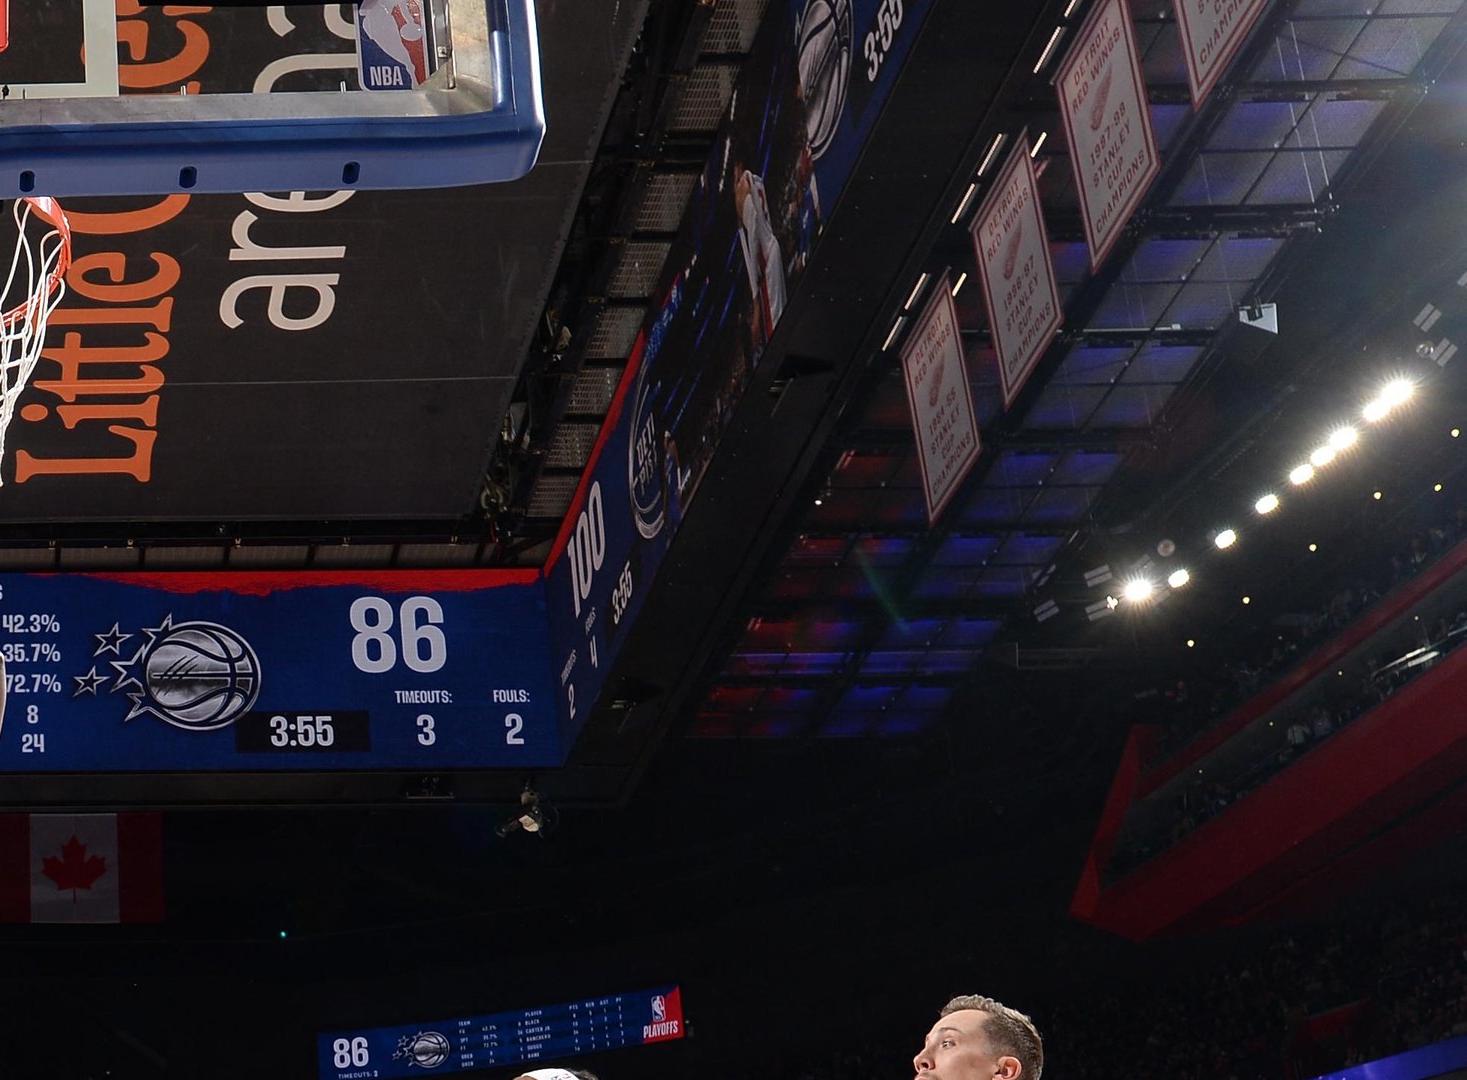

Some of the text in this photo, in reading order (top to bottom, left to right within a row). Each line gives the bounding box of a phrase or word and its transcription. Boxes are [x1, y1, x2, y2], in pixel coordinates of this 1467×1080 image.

[1073, 18, 1110, 86] DETROIT
[370, 65, 404, 87] NBA
[1073, 28, 1120, 114] RED WINGS
[1093, 120, 1132, 188] STANLEY
[1107, 157, 1124, 190] CUP
[988, 178, 1020, 236] DETROIT
[1096, 152, 1145, 234] CHAMPIONS
[1006, 274, 1039, 332] STANLEY
[1008, 303, 1051, 374] CHAMPIONS
[15, 252, 181, 483] Little
[567, 481, 605, 619] 100
[612, 560, 633, 625] 3:55
[2, 614, 61, 633] 42.3%
[349, 595, 448, 674] 86
[3, 644, 61, 662] 35.7%
[6, 674, 61, 693] 72.7%
[394, 690, 453, 705] TIMEOUTS:
[492, 689, 531, 703] FOULS:
[27, 705, 39, 724] 8
[417, 714, 436, 747] 3
[504, 713, 524, 746] 2
[22, 733, 45, 753] 24
[269, 715, 335, 748] 3:55
[643, 1020, 679, 1038] PLAYOFFS
[333, 1036, 370, 1069] 86
